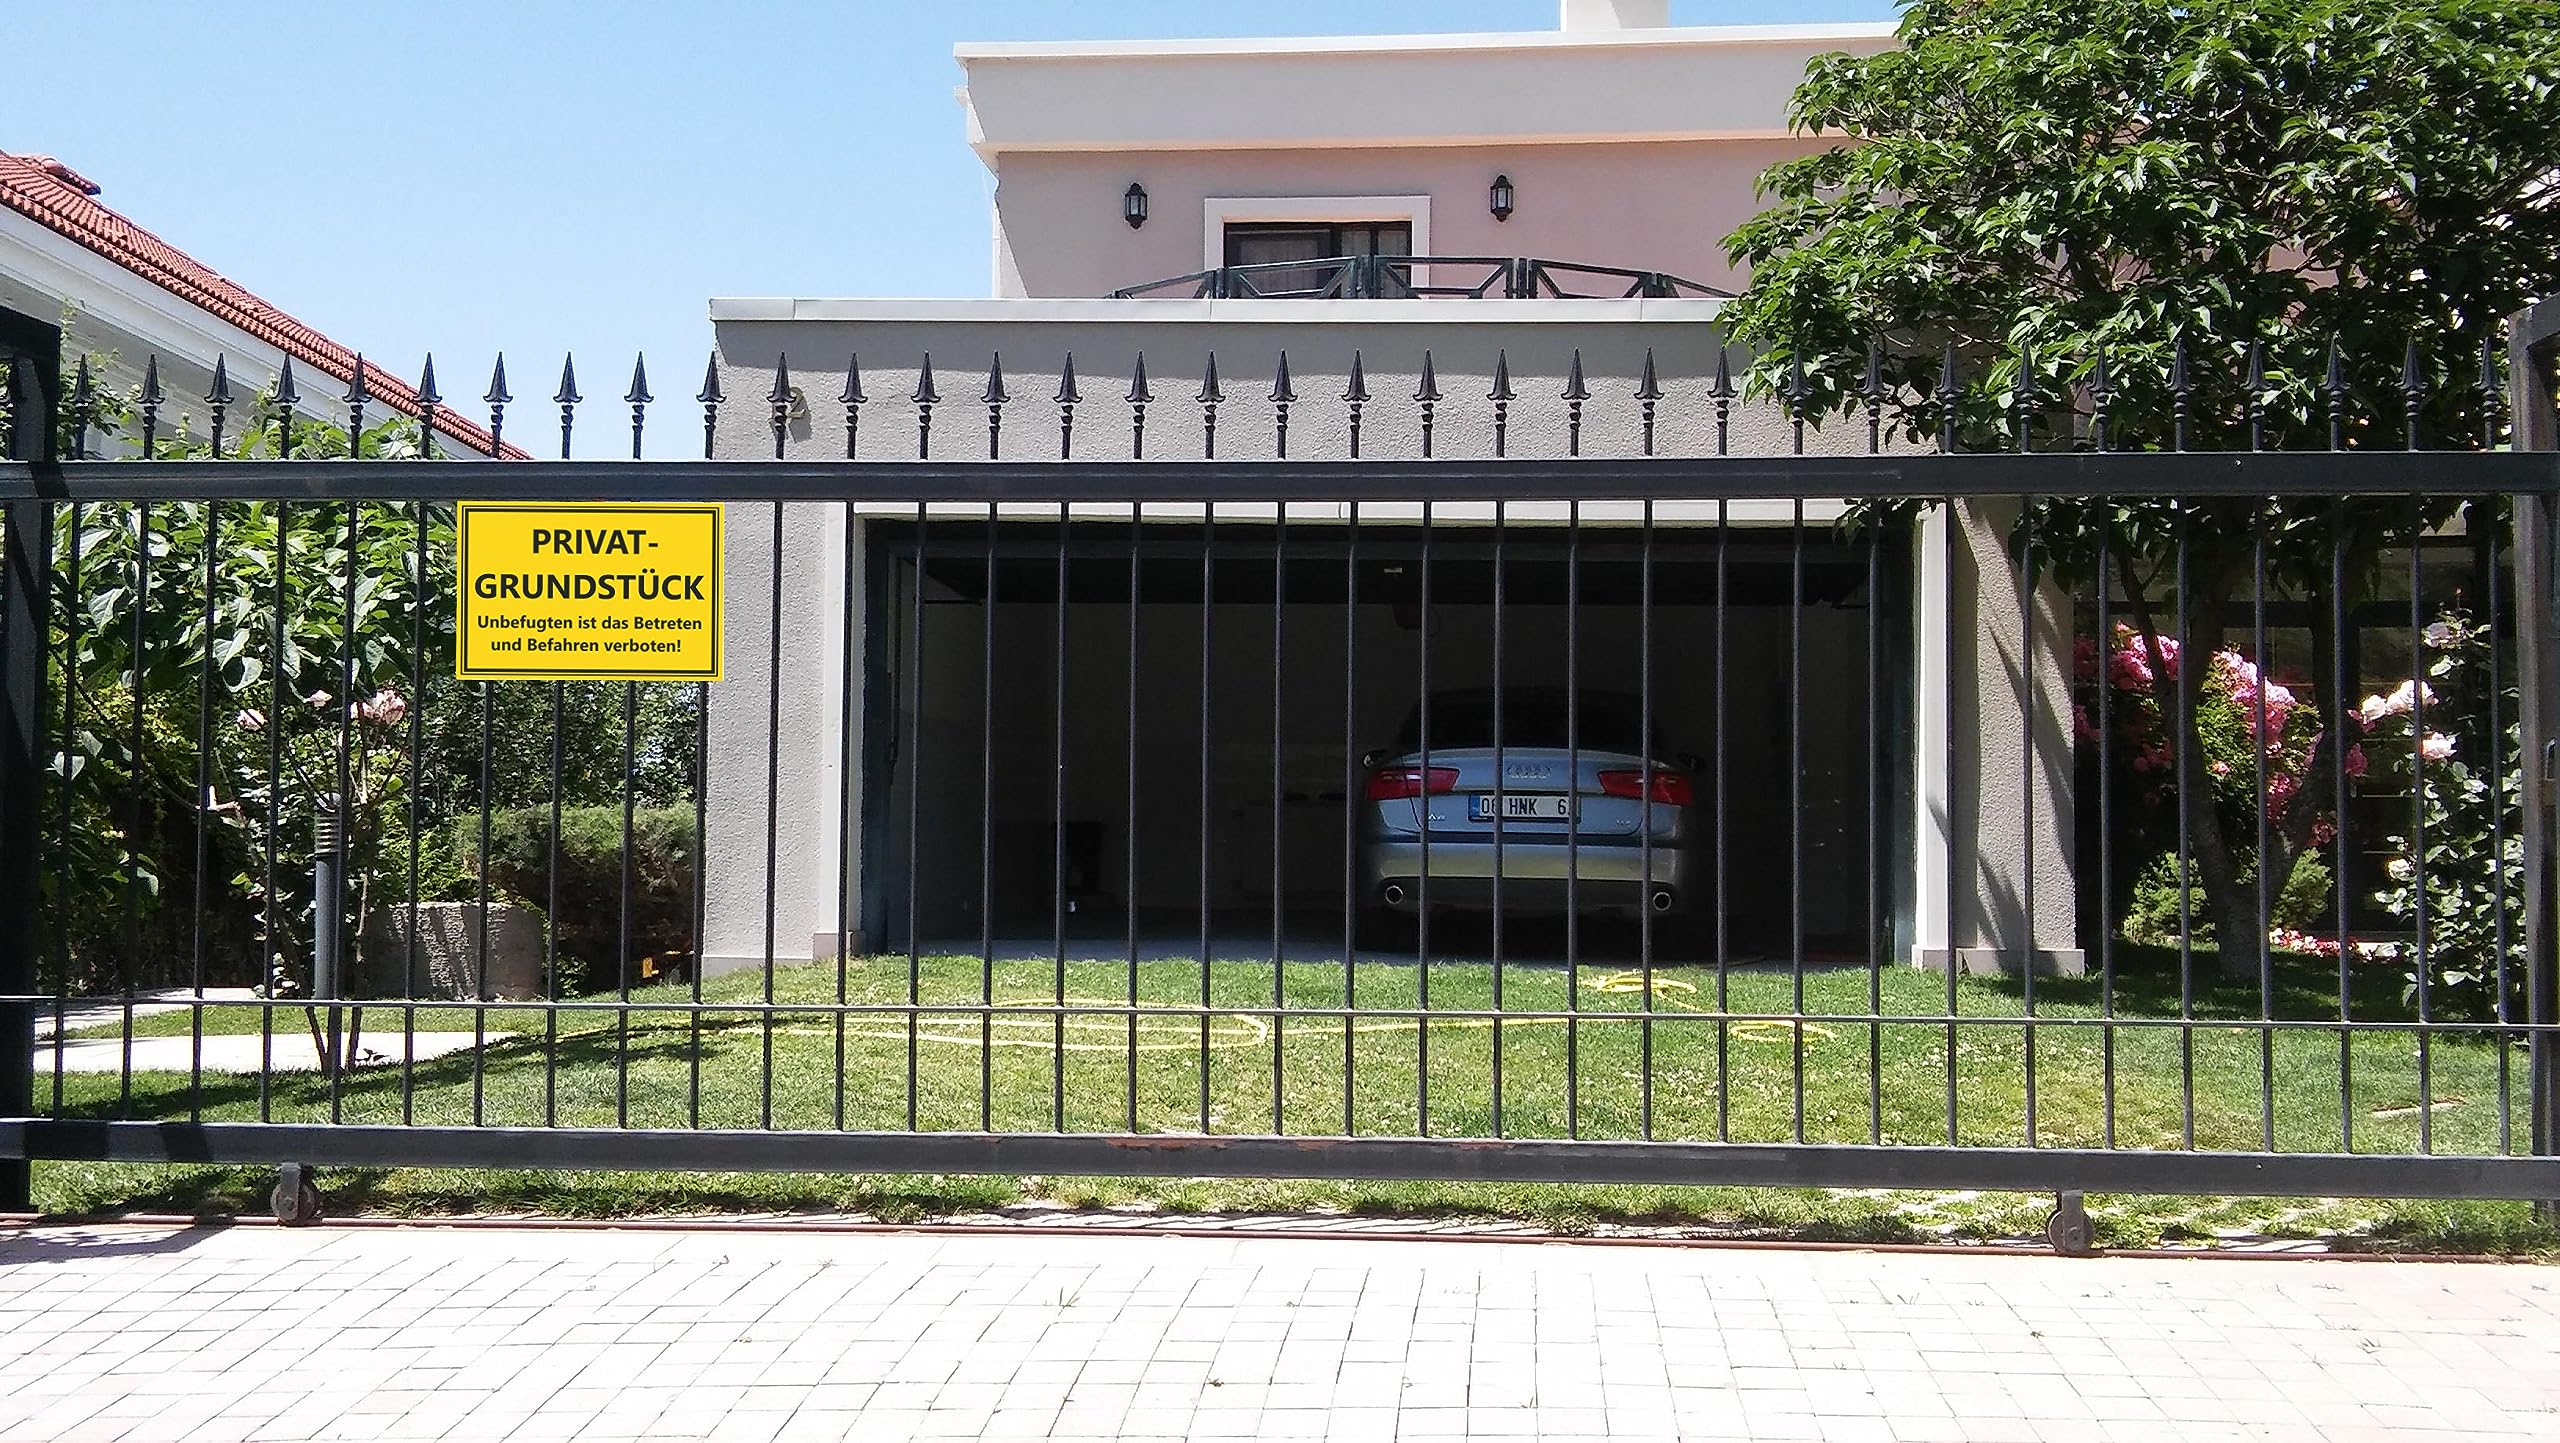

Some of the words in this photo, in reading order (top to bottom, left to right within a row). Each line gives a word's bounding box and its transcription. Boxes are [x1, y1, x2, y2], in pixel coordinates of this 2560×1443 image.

[533, 529, 658, 554] PRIVAT-
[475, 569, 704, 600] GRUNDSTÜCK
[478, 615, 572, 632] Unbefugten
[579, 616, 596, 629] ist
[602, 616, 628, 629] das
[635, 617, 701, 629] Betreten
[492, 638, 521, 651] und
[528, 638, 598, 651] Befahren
[604, 639, 680, 652] verboten!
[1509, 798, 1537, 815] HNK
[1557, 799, 1575, 815] 6
